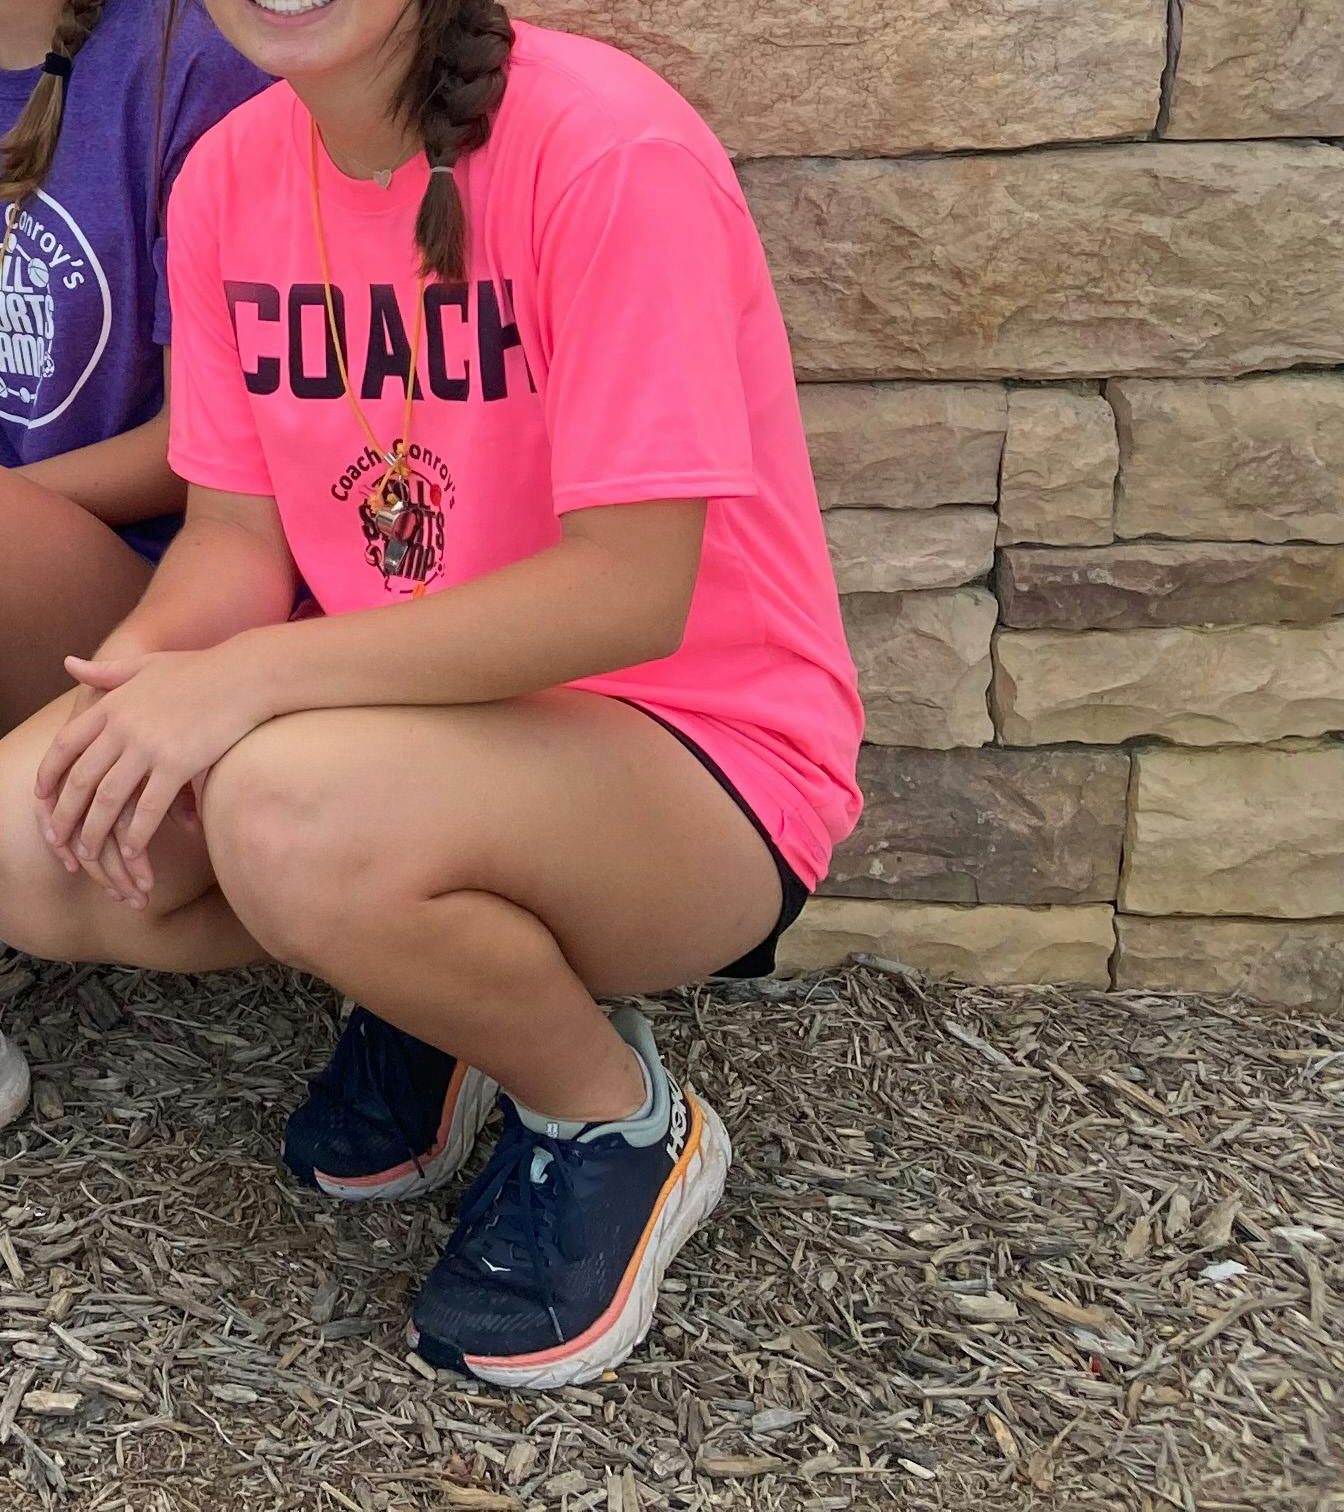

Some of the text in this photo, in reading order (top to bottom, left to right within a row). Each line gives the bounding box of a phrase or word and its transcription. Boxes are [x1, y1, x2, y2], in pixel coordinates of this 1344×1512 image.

[4, 202, 85, 290] Conroy's
[223, 279, 538, 402] COACH
[330, 446, 382, 502] Coach
